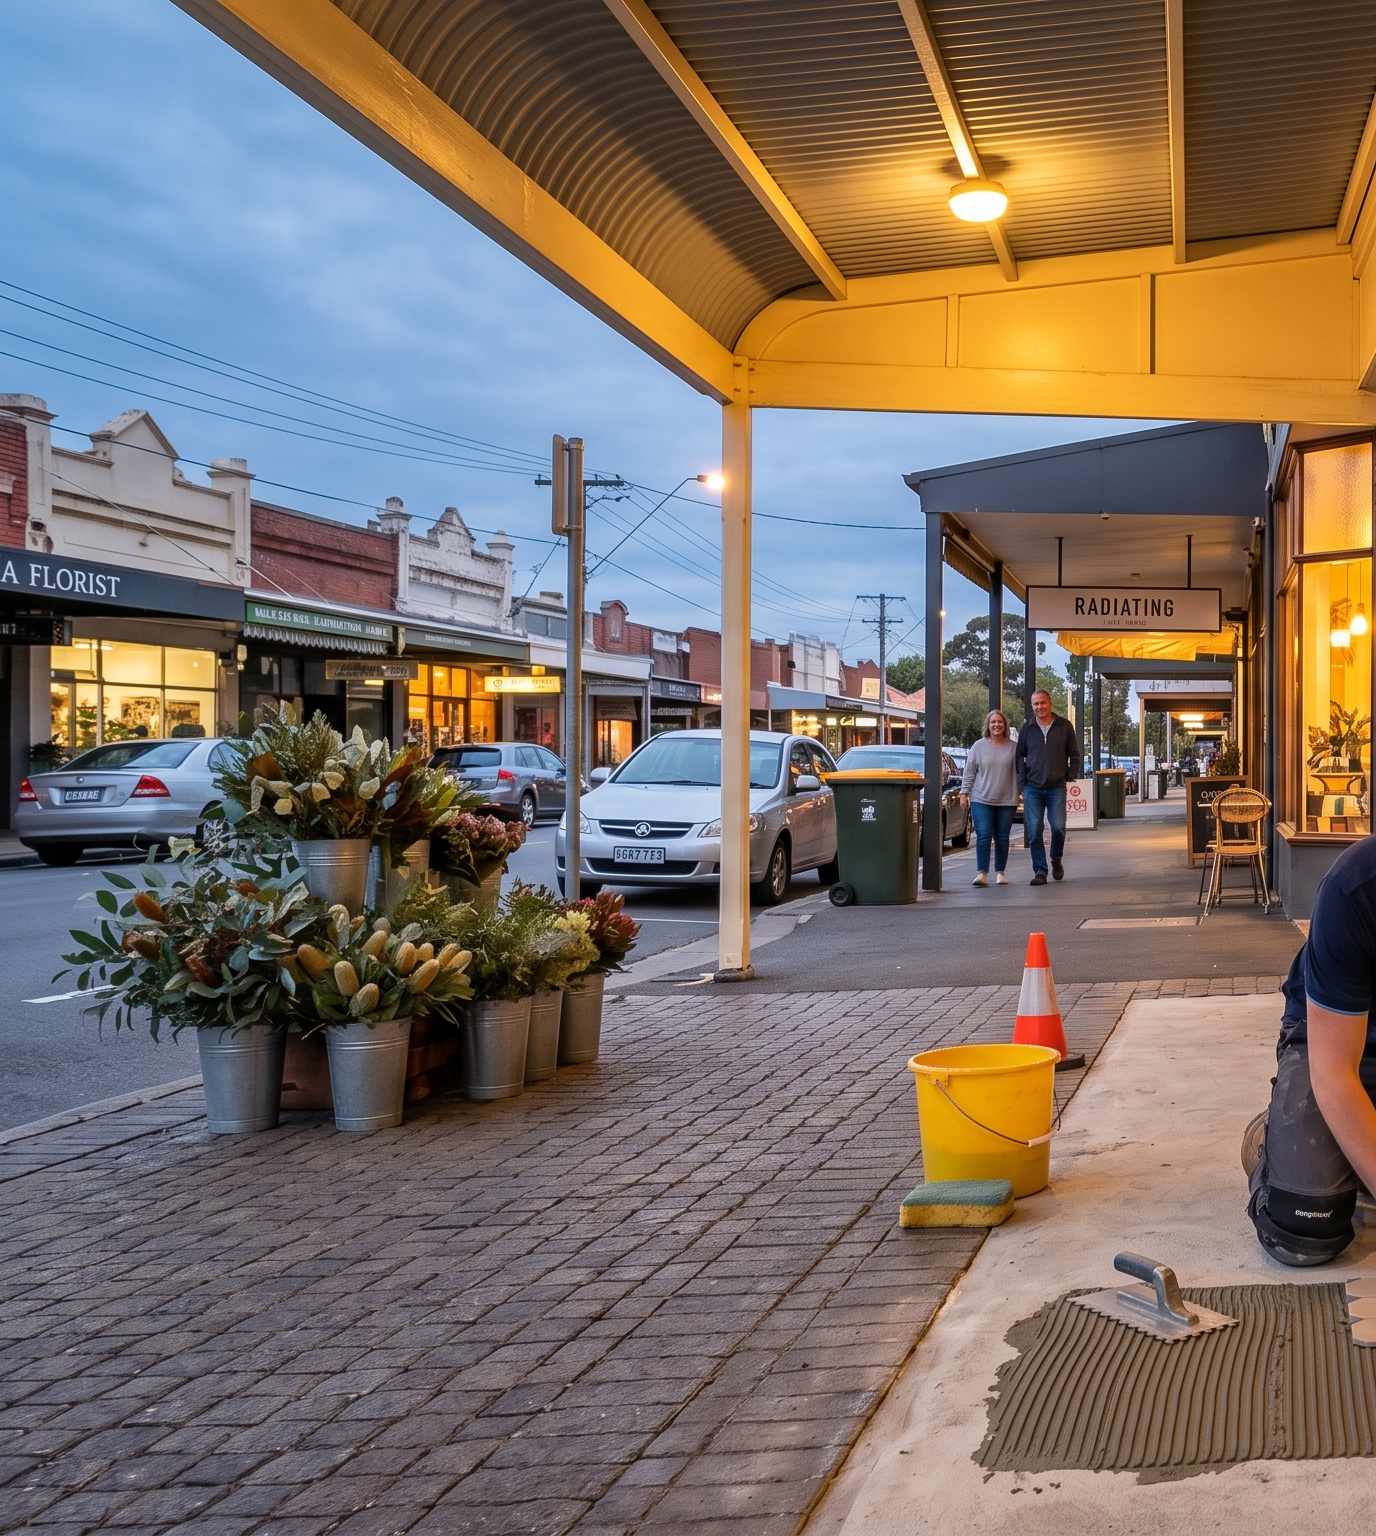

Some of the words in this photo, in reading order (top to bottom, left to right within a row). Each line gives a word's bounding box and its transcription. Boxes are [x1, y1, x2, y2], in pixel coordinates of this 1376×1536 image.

[0, 560, 20, 585] A
[29, 563, 120, 598] FLORIST
[1075, 596, 1174, 617] RADIATING
